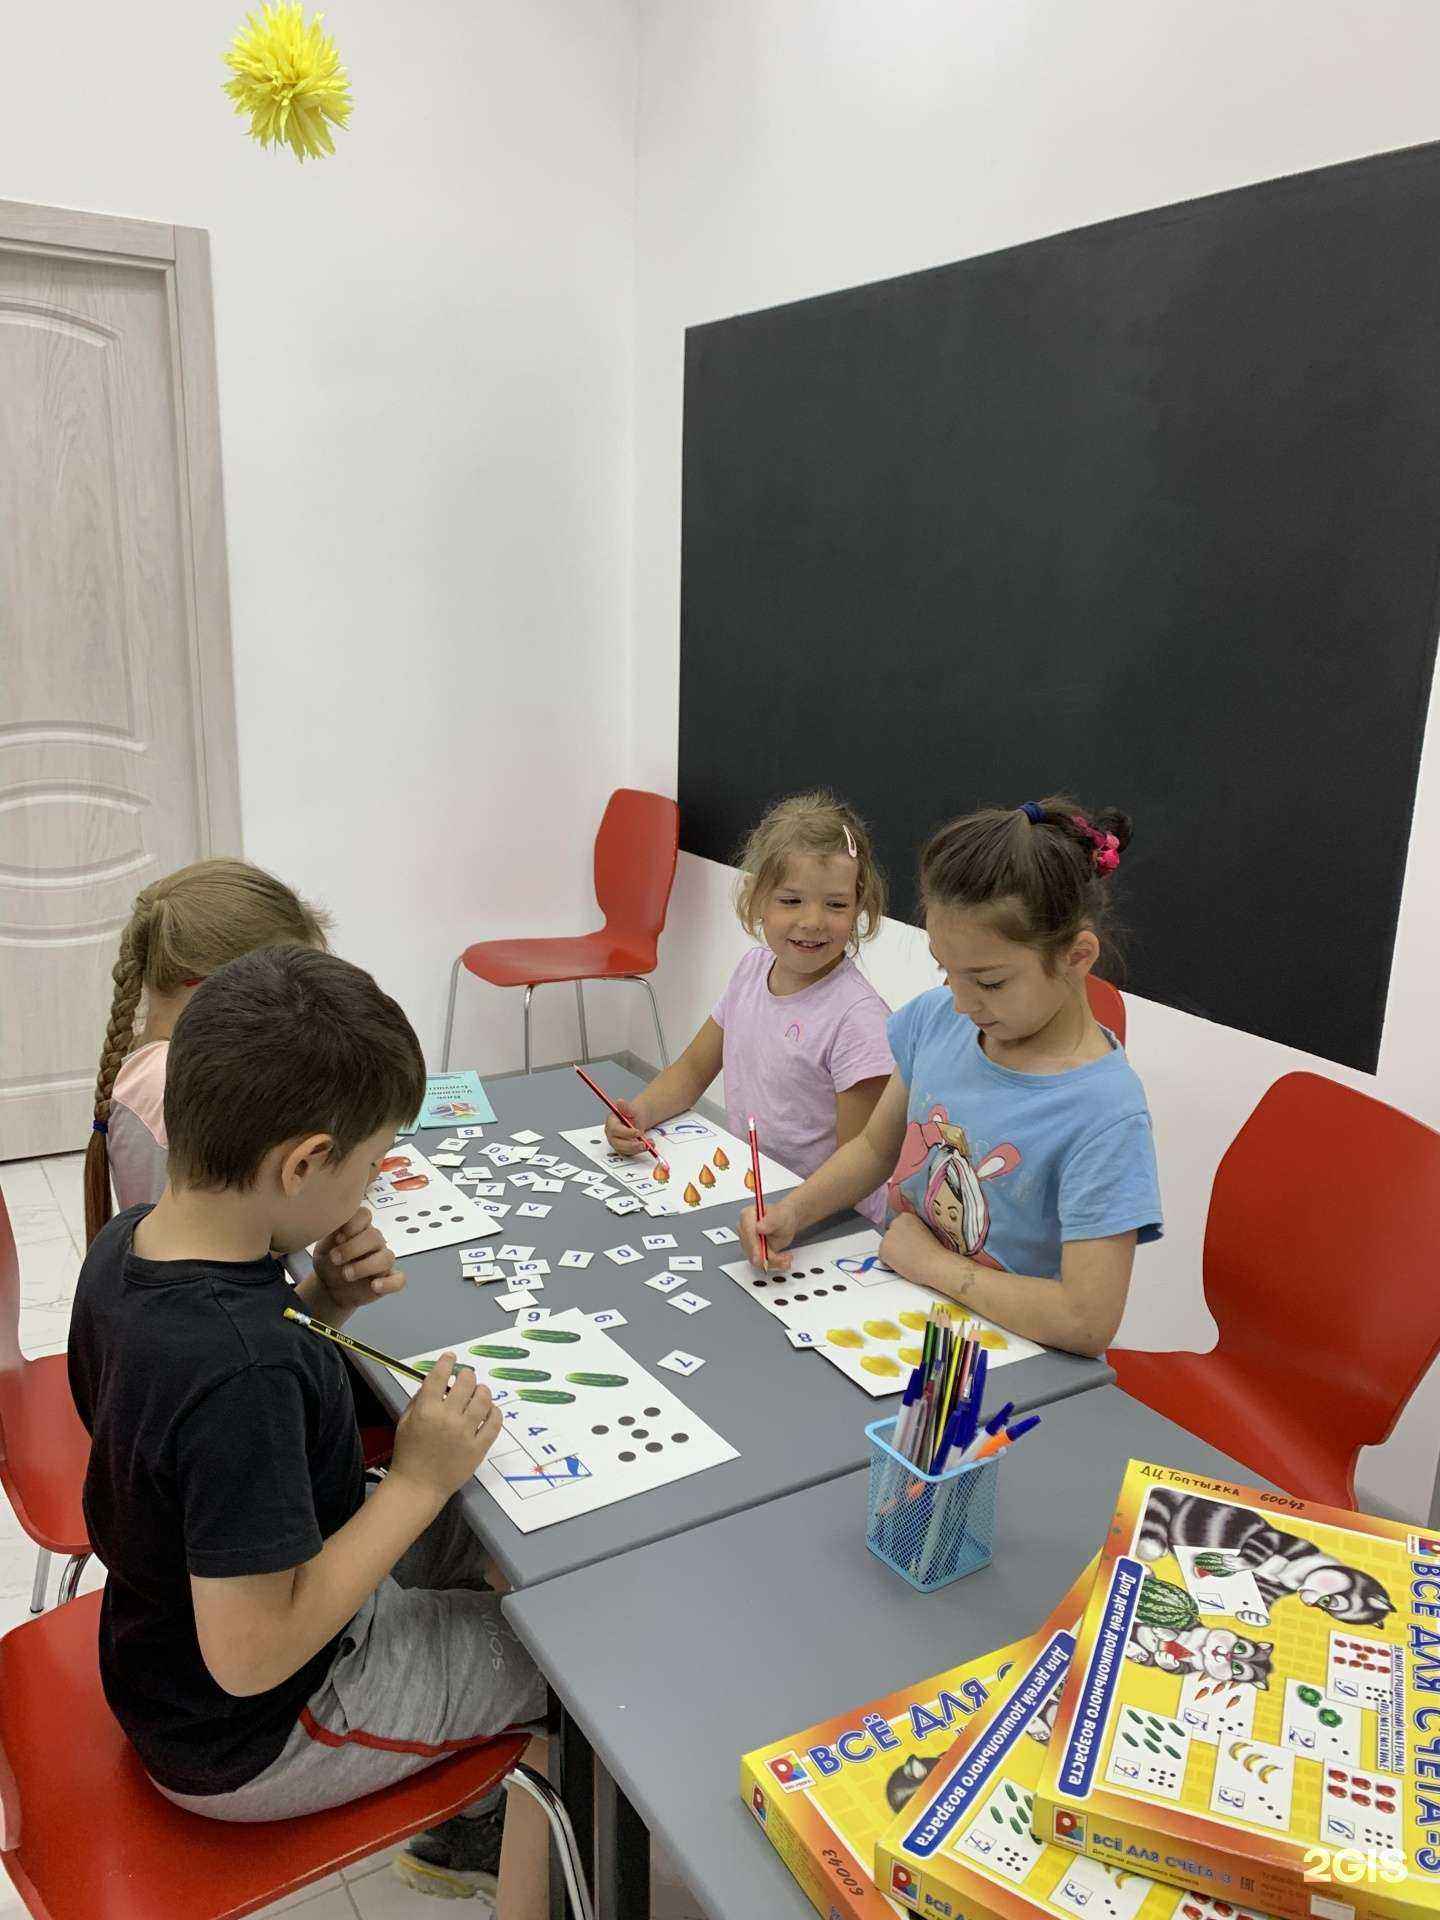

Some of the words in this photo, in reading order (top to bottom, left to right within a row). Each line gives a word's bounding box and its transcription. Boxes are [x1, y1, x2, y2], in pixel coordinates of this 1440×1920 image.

[519, 1263, 538, 1271] 5
[616, 1248, 632, 1258] 0
[511, 1278, 531, 1286] 5
[658, 1276, 676, 1286] 3
[527, 1425, 548, 1437] 4
[1118, 1571, 1137, 1597] Для
[1110, 1593, 1131, 1632] детей
[1049, 1645, 1070, 1671] Для
[1023, 1666, 1052, 1707] детей
[1086, 1629, 1120, 1720] дошкольного
[808, 1713, 902, 1777] ВСЁ
[911, 1678, 990, 1740] ДЛЯ
[962, 1698, 1028, 1788] дошкольного
[1067, 1718, 1098, 1787] возраста
[915, 1787, 967, 1848] возраста
